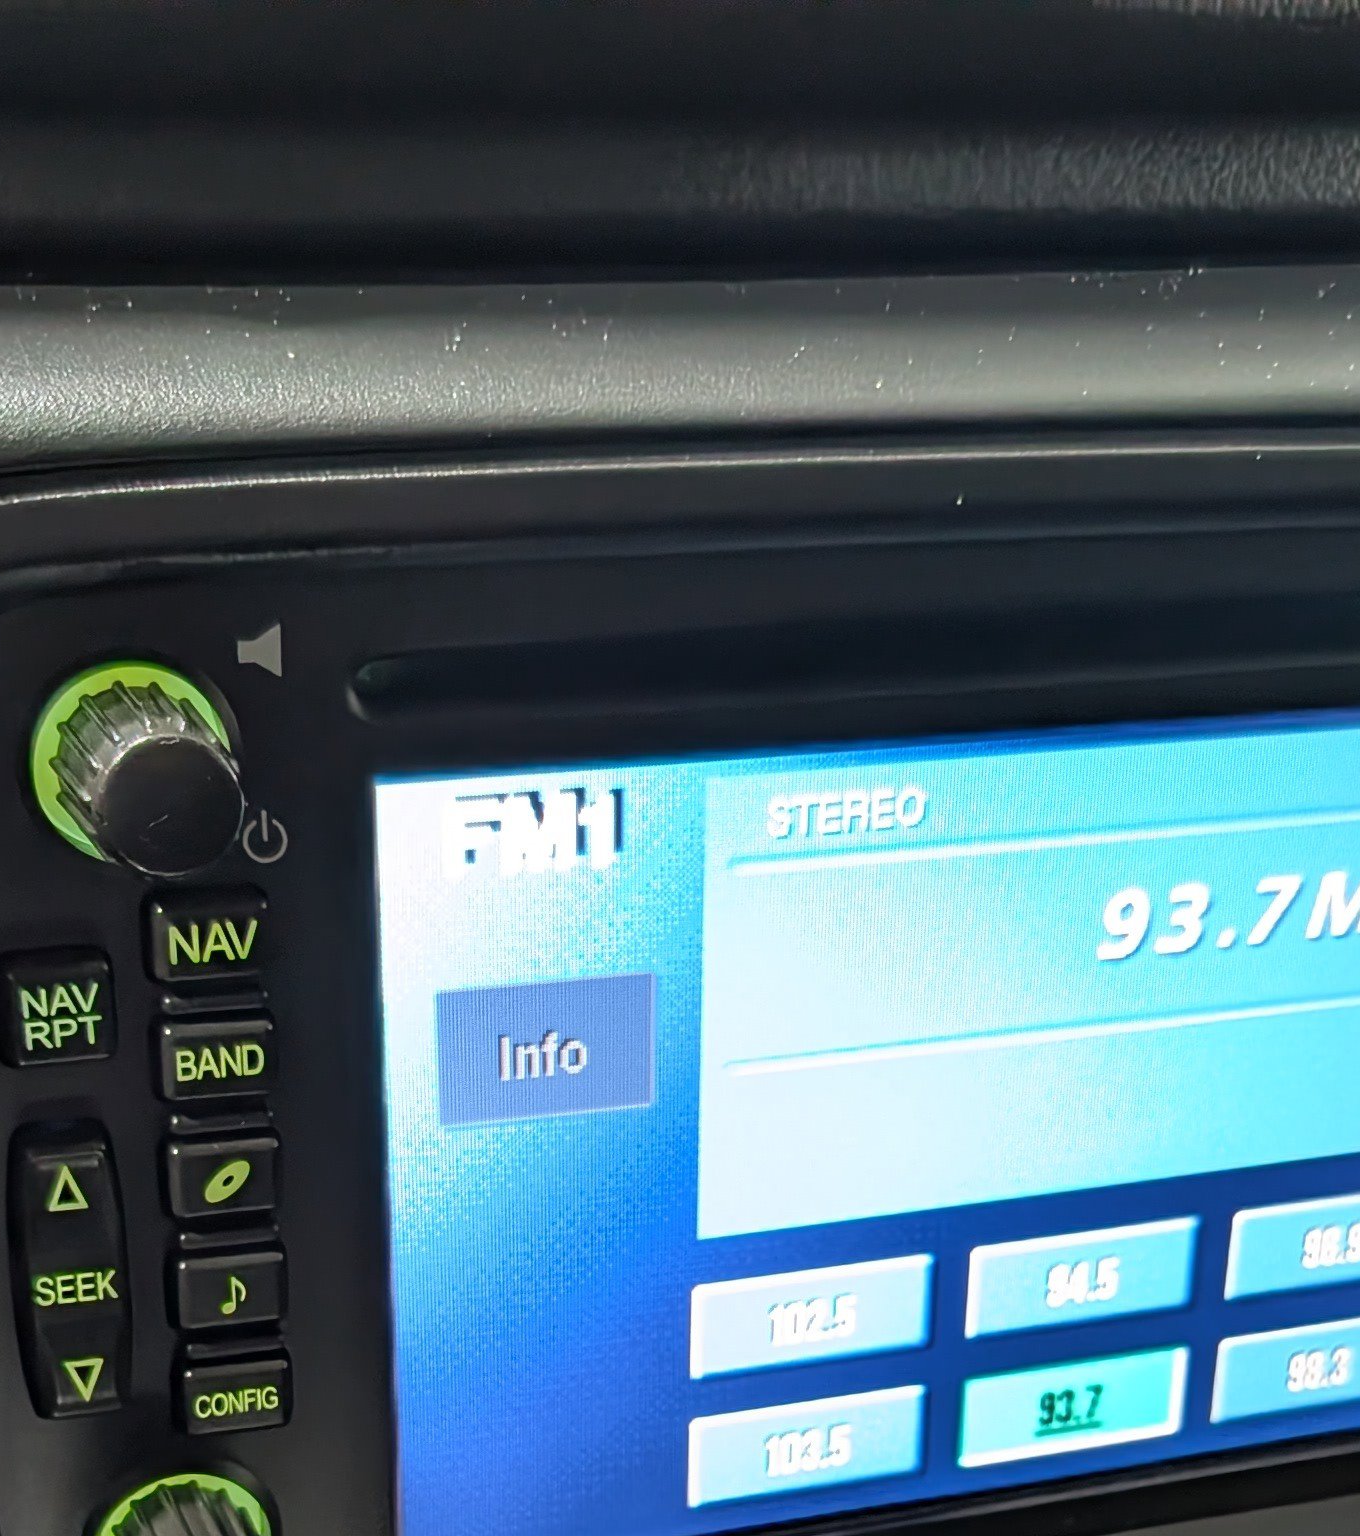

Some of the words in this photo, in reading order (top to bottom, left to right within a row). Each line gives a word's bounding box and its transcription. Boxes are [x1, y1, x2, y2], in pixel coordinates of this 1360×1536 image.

[442, 787, 623, 876] FM1
[765, 787, 927, 839] STEREO
[1096, 874, 1302, 961] 93.7
[168, 918, 258, 965] NAV
[20, 979, 99, 1019] NAV
[24, 1015, 102, 1050] RPT
[176, 1044, 265, 1082] BAND
[498, 1031, 588, 1081] Info
[34, 1269, 119, 1306] SEEK
[195, 1387, 279, 1419] CONFIG
